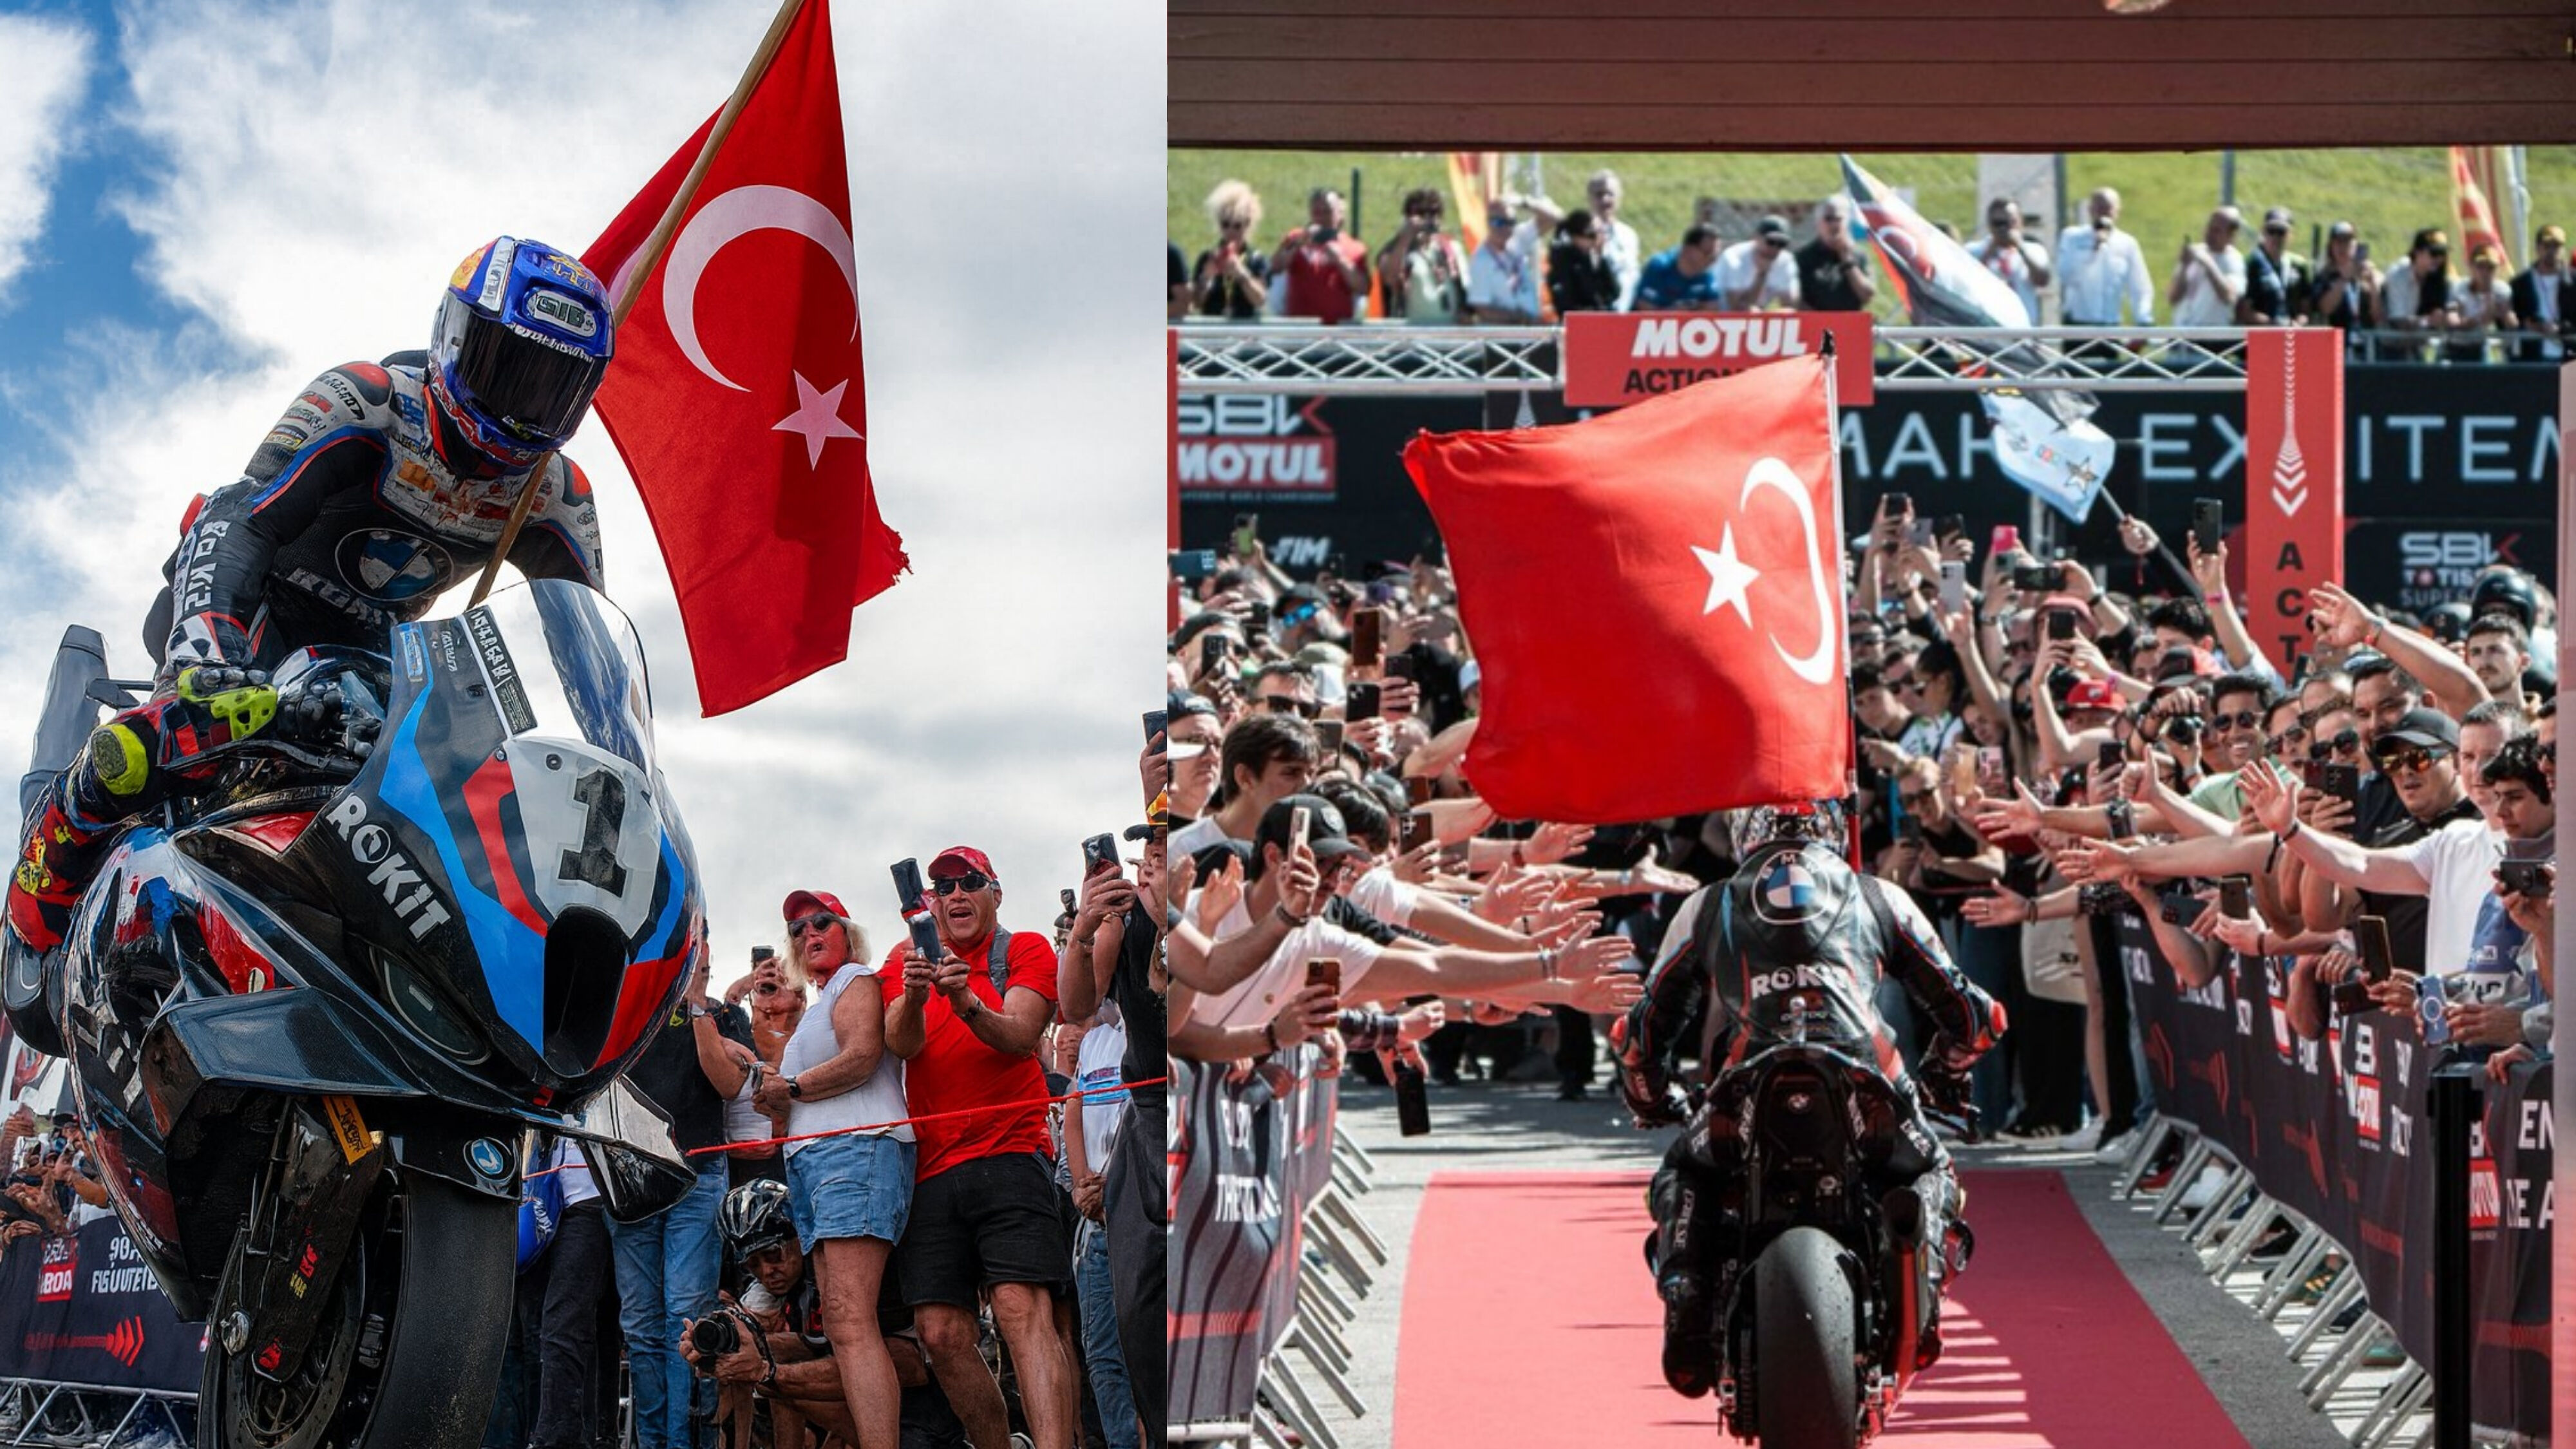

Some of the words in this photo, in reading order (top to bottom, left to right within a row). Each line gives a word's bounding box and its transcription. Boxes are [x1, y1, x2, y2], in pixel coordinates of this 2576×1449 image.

[1631, 319, 1807, 357] MOTUL
[2401, 533, 2522, 565] SBK
[558, 769, 628, 898] 1
[1750, 964, 1846, 999] ROK
